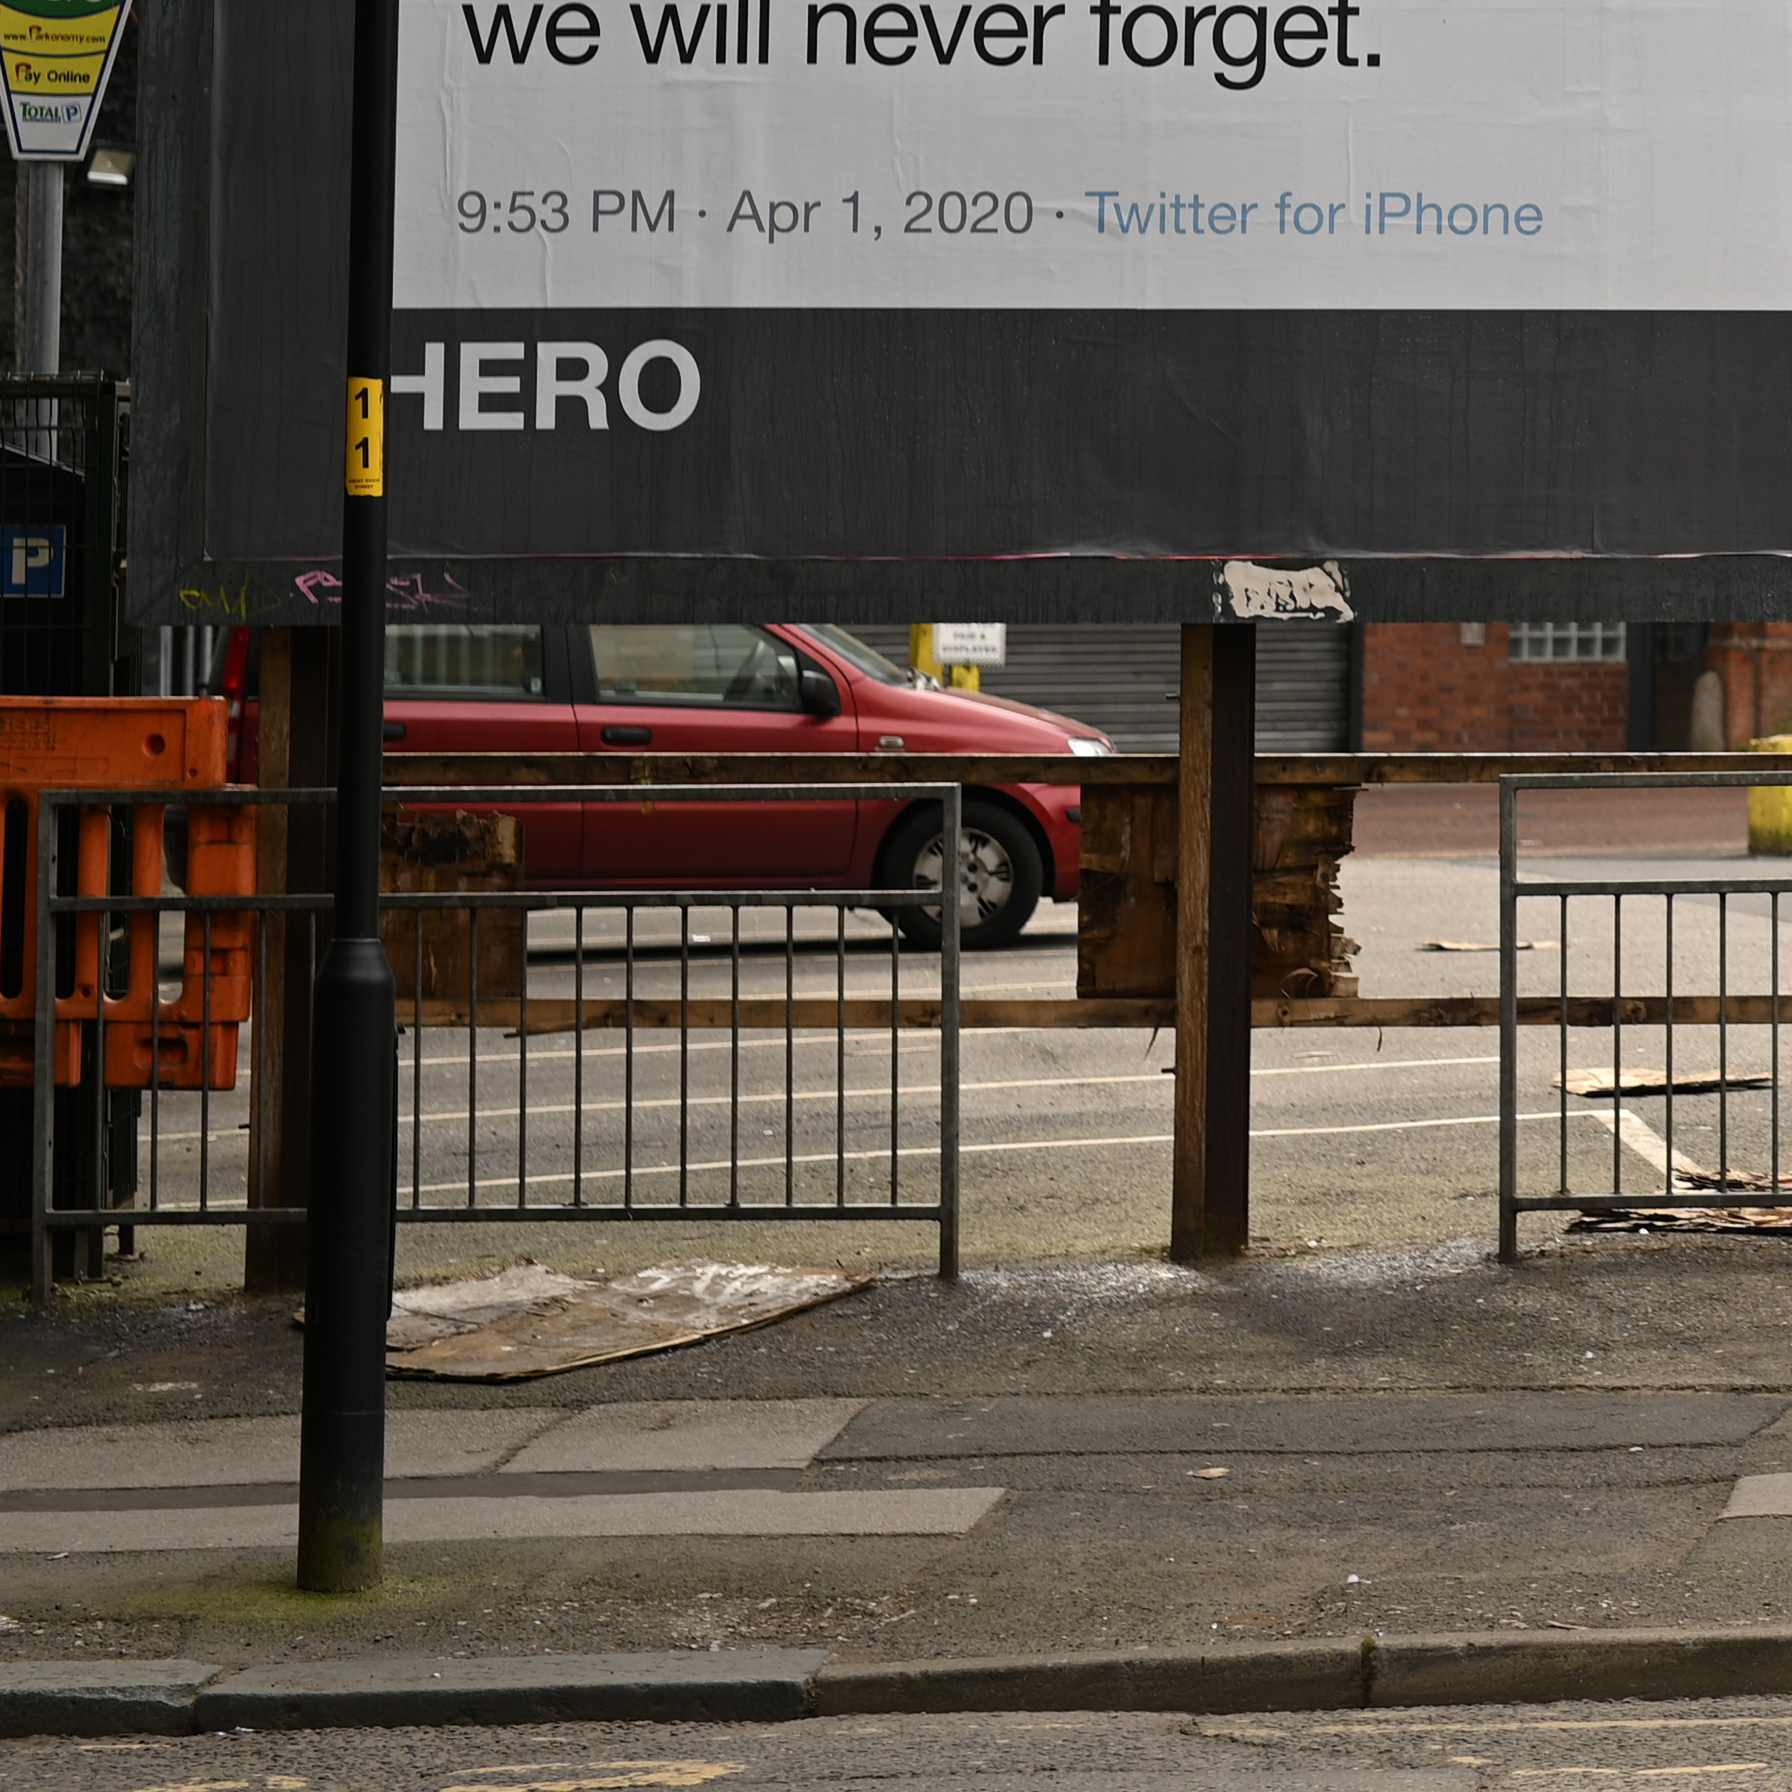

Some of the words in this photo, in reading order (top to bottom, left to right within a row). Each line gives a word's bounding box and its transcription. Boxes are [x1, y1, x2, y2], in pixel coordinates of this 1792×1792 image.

[461, 2, 602, 66] we
[805, 2, 1067, 67] never
[47, 69, 91, 84] Online
[457, 190, 571, 234] 9:53
[592, 189, 676, 234] PM
[725, 189, 822, 244] Apr
[842, 190, 883, 241] 1,
[902, 190, 1034, 234] 2020
[1085, 191, 1258, 235] Twitter
[1275, 191, 1346, 235] for
[1365, 192, 1543, 236] iPhone
[390, 339, 702, 431] HERO
[12, 538, 54, 585] P
